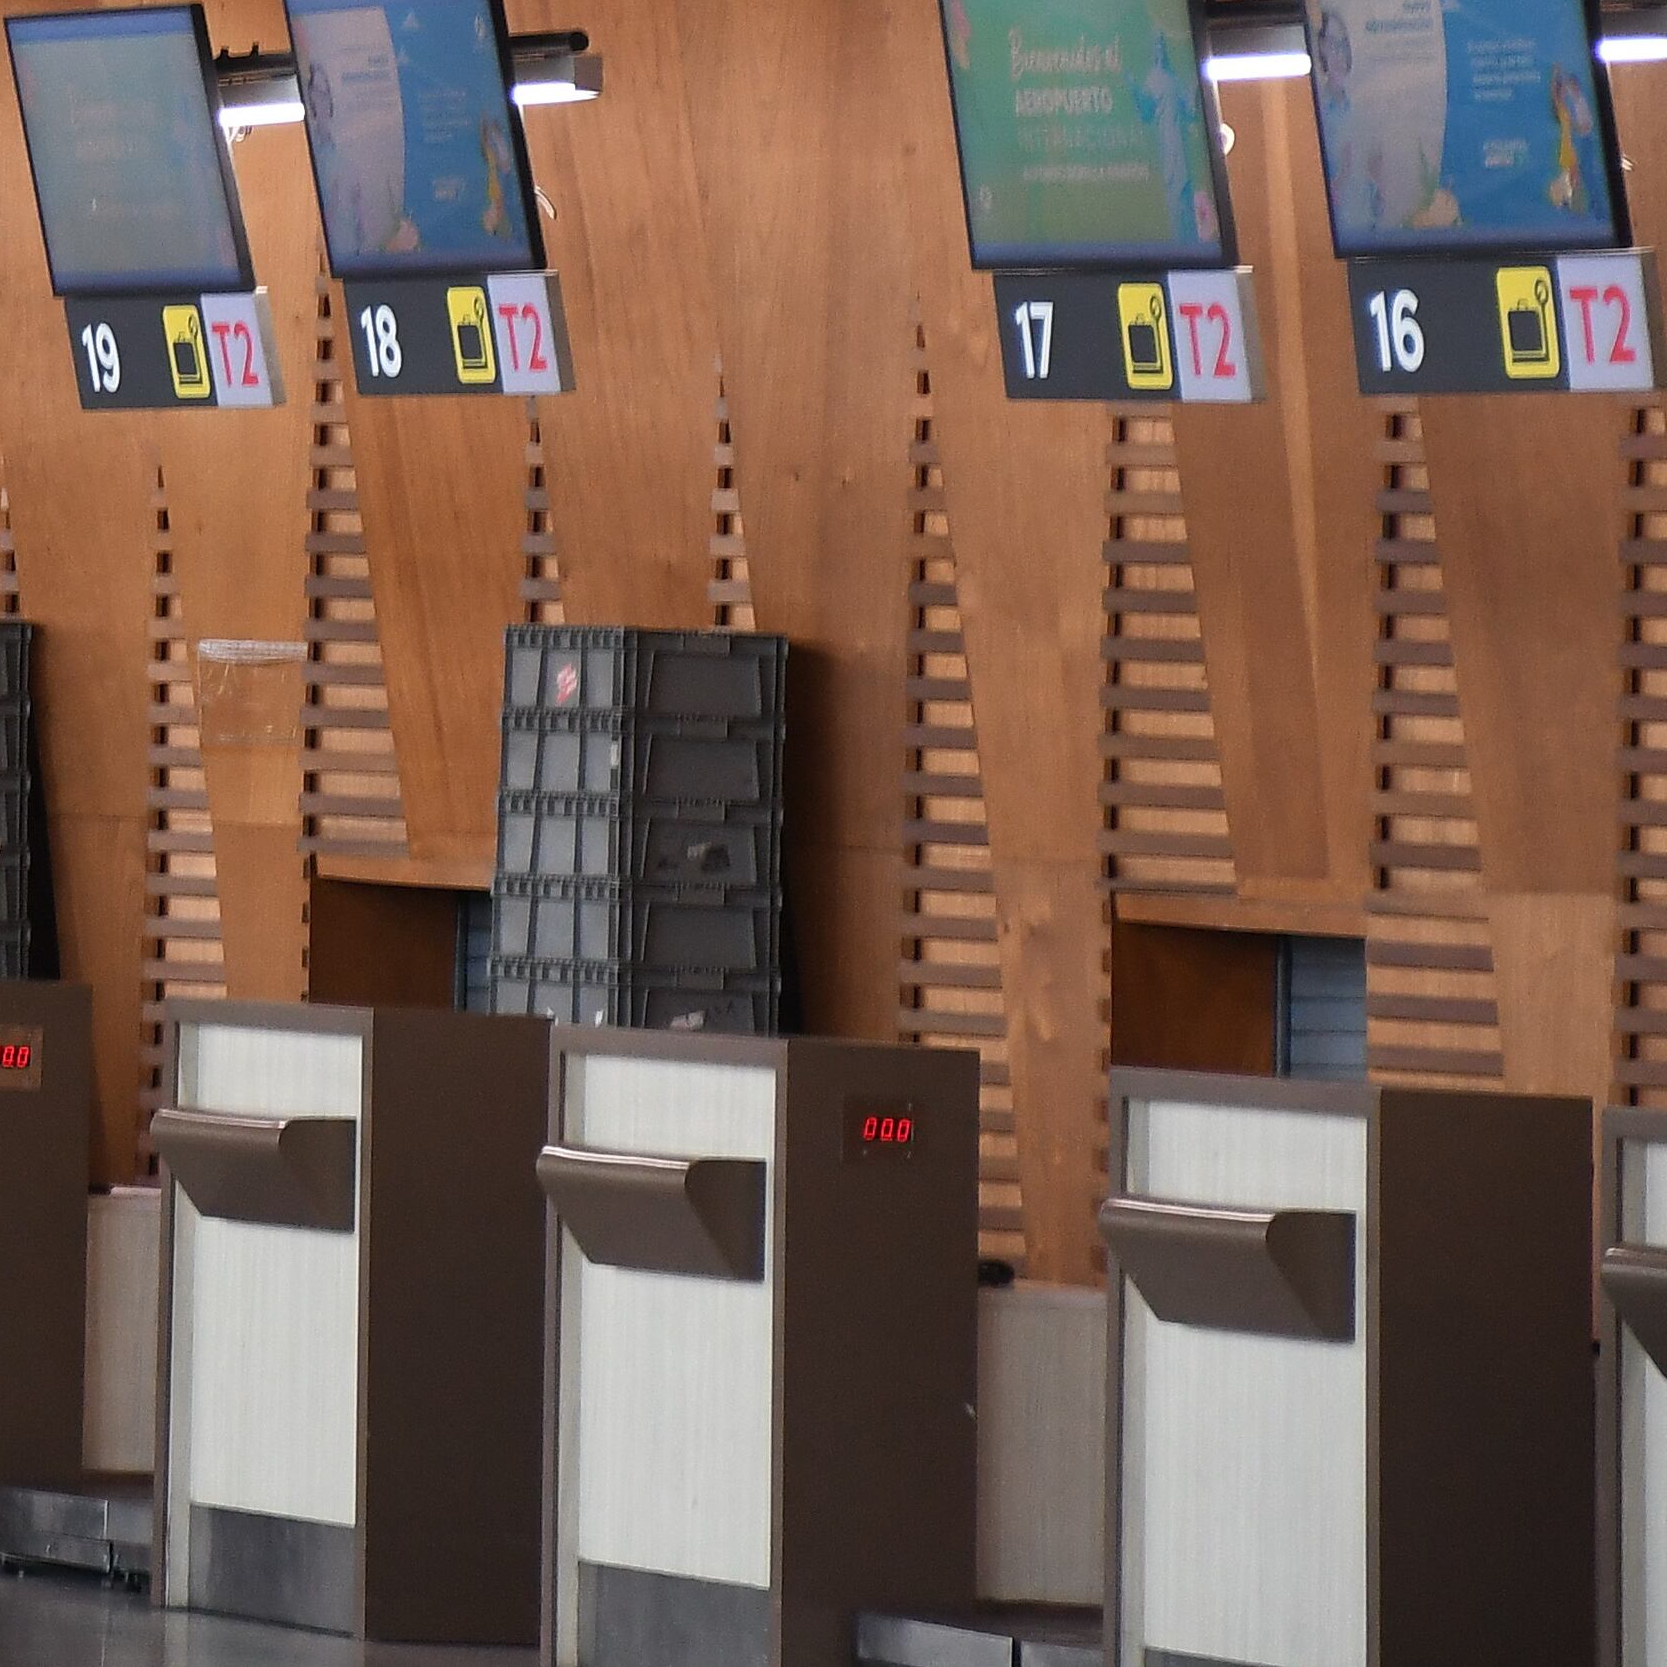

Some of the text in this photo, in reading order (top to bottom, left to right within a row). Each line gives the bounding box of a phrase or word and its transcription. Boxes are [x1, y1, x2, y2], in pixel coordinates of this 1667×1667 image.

[81, 322, 259, 394] 19 T2
[360, 304, 548, 378] 18 T2
[1014, 300, 1236, 379] 17 T2
[1368, 286, 1636, 374] 16 T2
[863, 1117, 911, 1142] 000
